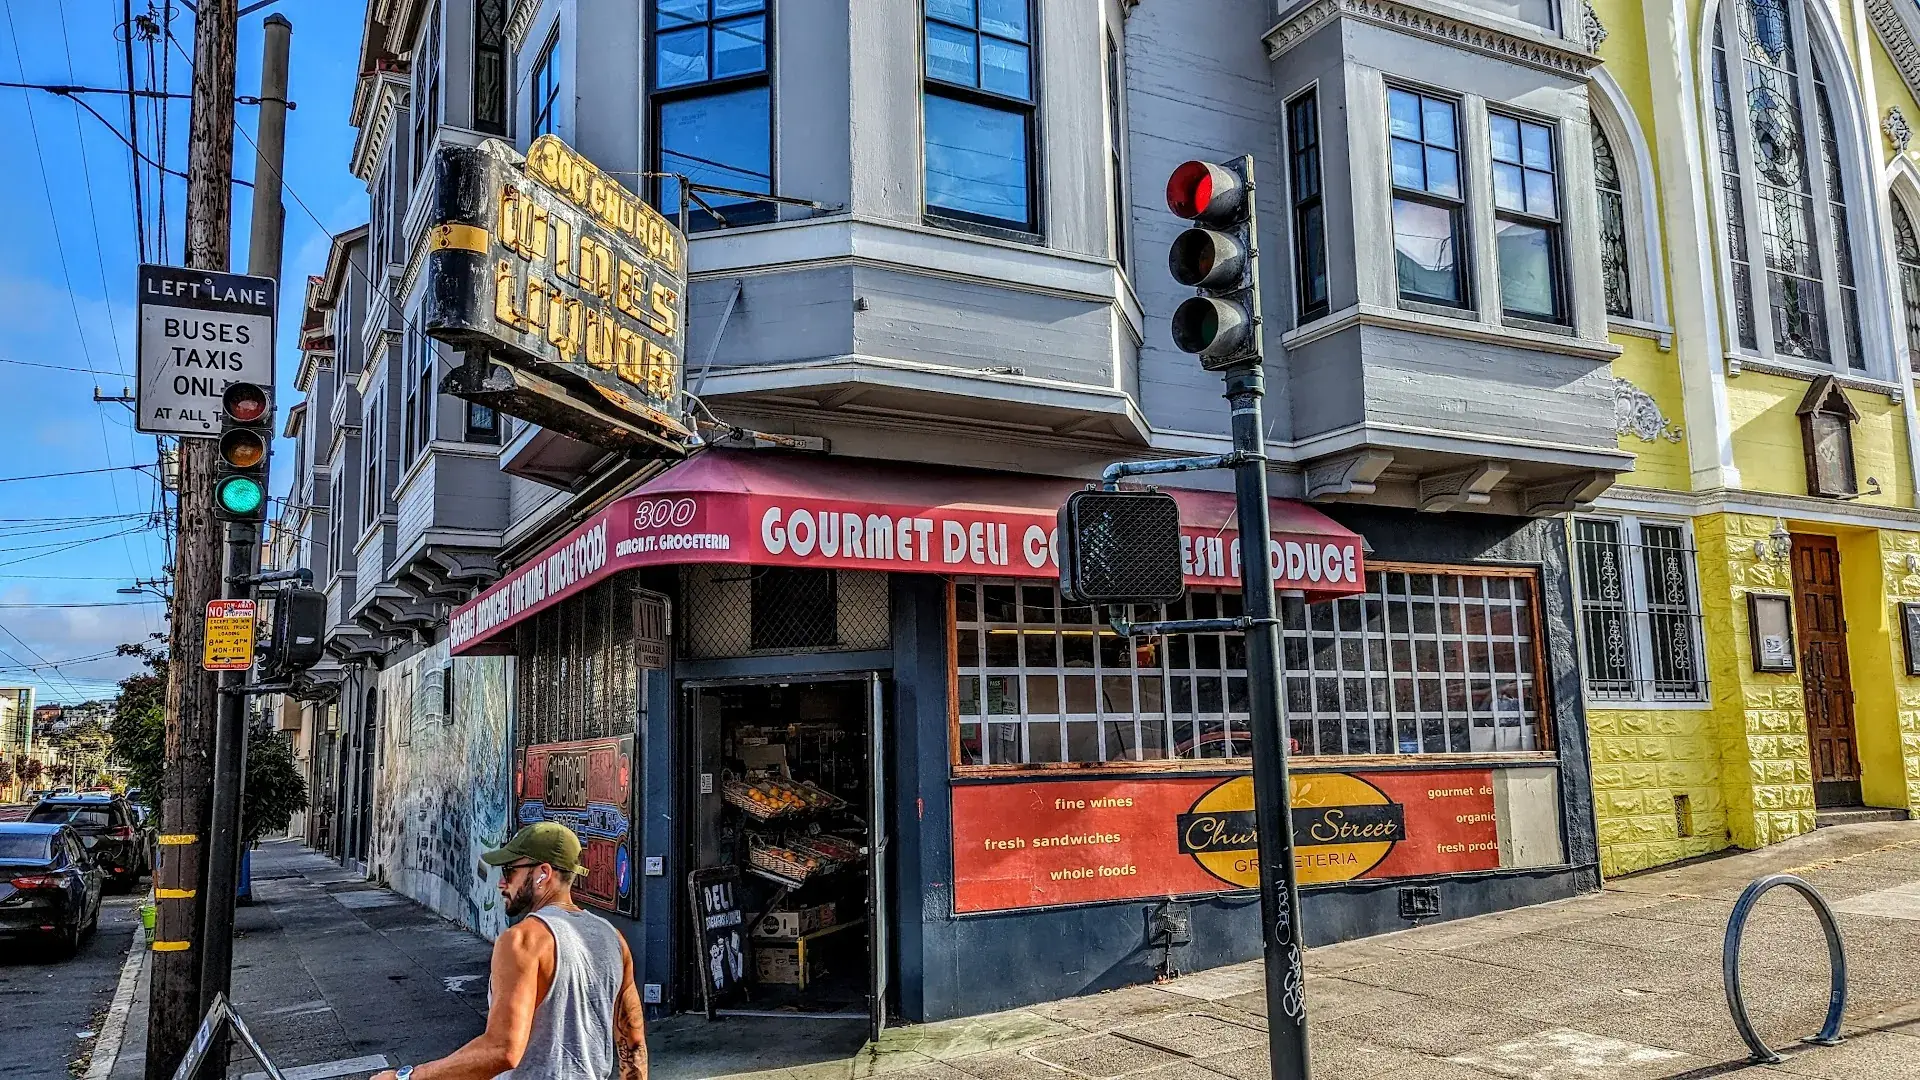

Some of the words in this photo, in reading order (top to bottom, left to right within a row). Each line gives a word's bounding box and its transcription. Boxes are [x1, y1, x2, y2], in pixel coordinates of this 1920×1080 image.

[540, 142, 586, 200] 300
[590, 178, 677, 266] CHURCH
[147, 278, 200, 298] LEFT
[210, 286, 267, 306] LANE
[164, 318, 250, 345] BUSES
[171, 346, 243, 371] TAXIS
[153, 407, 173, 420] AT
[178, 409, 207, 422] ALL
[634, 497, 697, 530] 300
[615, 537, 645, 557] CHURCH
[659, 533, 730, 550] GROCETERIA
[761, 506, 934, 562] GOURMET
[942, 520, 1009, 566] DELI
[1182, 534, 1225, 577] ESH
[1230, 537, 1357, 583] PODUCE
[547, 542, 574, 597] WHOLE
[574, 518, 607, 581] FOODS
[208, 606, 223, 618] NO
[637, 643, 665, 655] AVAILABLE
[1054, 797, 1085, 810] fine
[1090, 796, 1133, 809] wines
[1427, 786, 1474, 800] gourmet
[1311, 808, 1398, 842] Street
[984, 835, 1025, 851] fresh
[1032, 831, 1121, 849] sandwiches
[1436, 841, 1466, 854] fresh
[1050, 867, 1094, 881] whole
[1098, 864, 1137, 878] foods
[1234, 851, 1358, 873] GRETERIA
[704, 881, 734, 912] DELI
